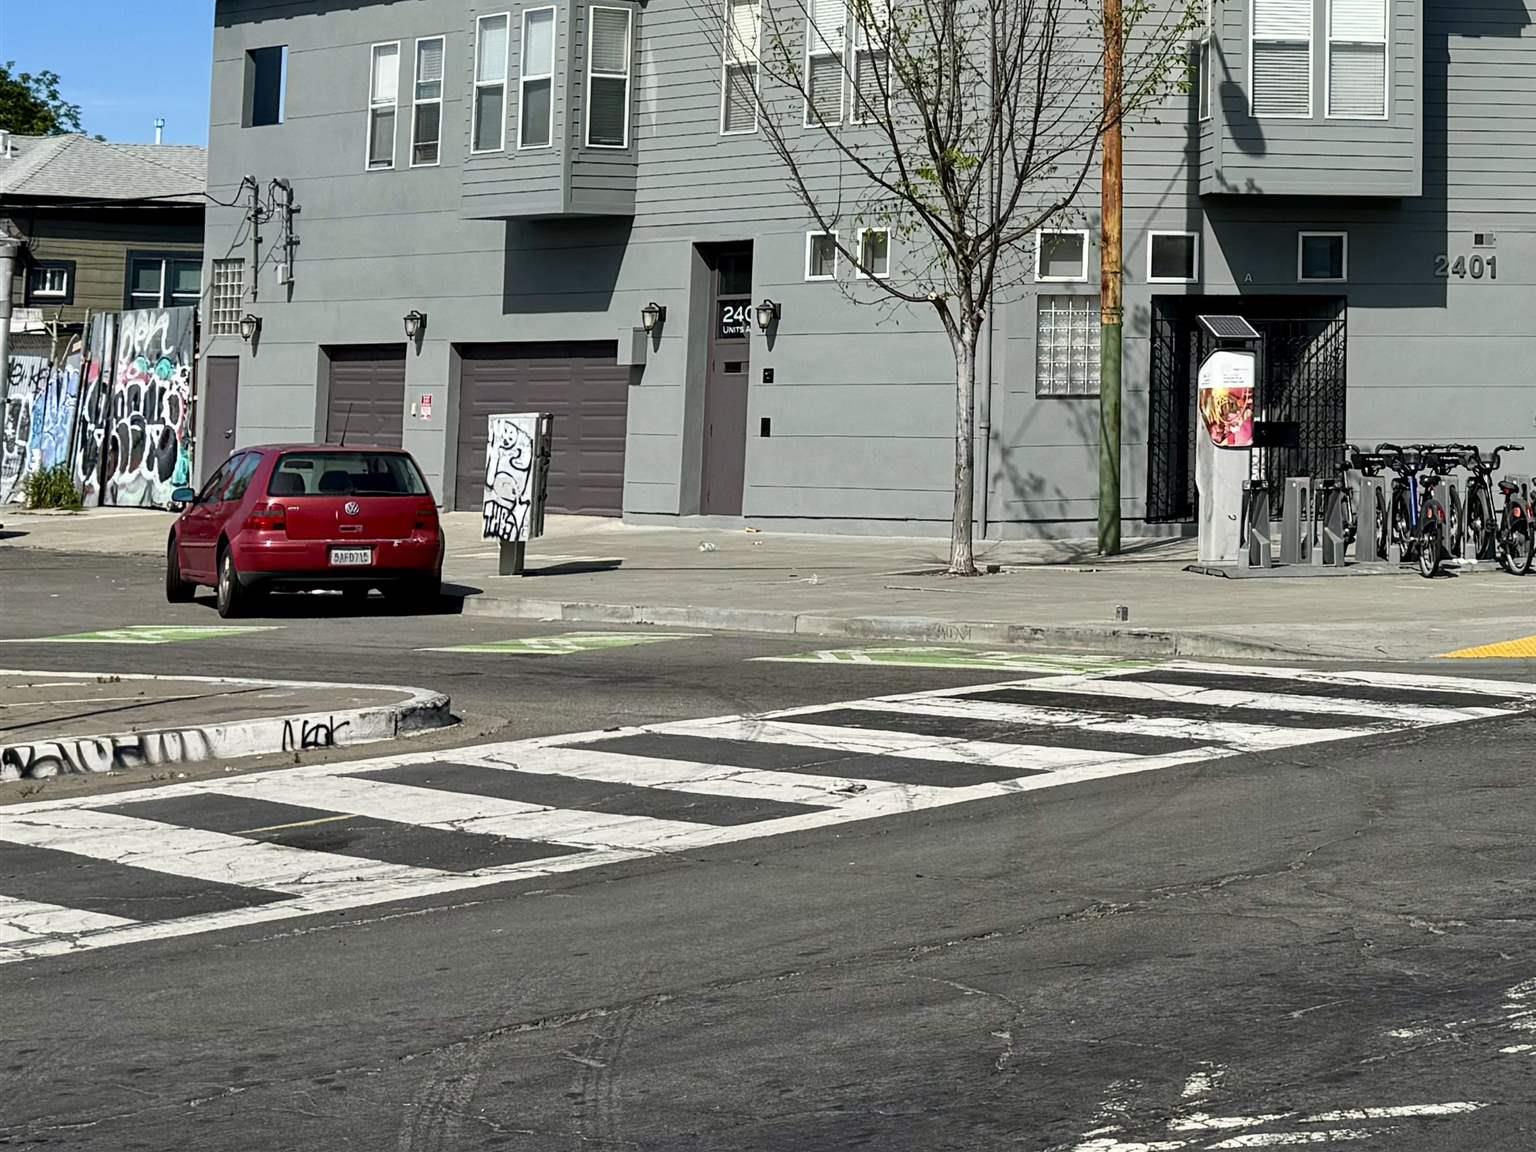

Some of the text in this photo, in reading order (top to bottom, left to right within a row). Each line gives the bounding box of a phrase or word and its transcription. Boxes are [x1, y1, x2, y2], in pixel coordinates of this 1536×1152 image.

[1434, 254, 1497, 279] 2401
[1245, 273, 1253, 282] A
[722, 326, 744, 334] UNITS
